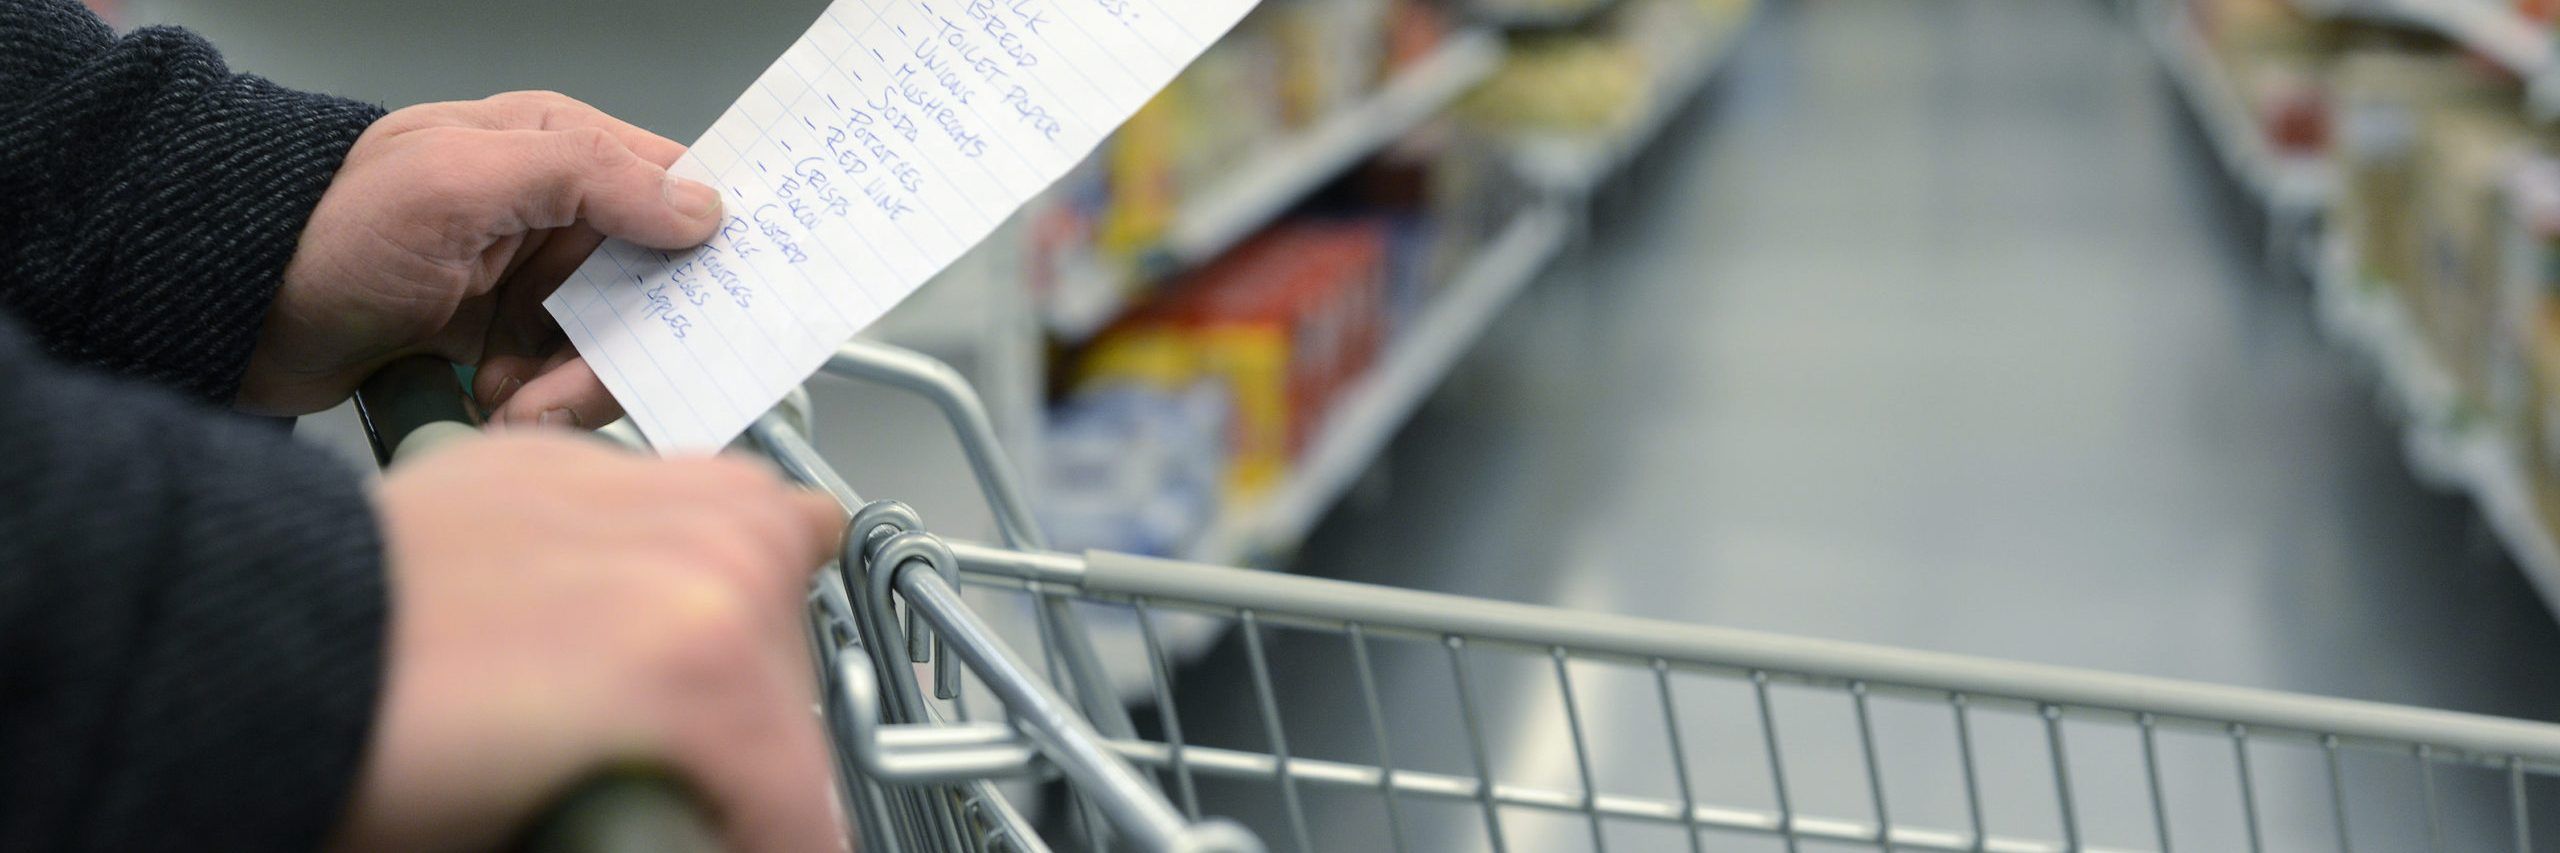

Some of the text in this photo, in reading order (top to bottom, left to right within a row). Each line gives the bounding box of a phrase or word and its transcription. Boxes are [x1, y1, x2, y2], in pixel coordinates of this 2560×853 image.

[914, 37, 976, 105] UNIONS
[939, 15, 1061, 142] TOILET PAPER
[895, 63, 989, 158] MUSHROOMS
[826, 125, 915, 220] RED WINE
[846, 107, 924, 194] POTATOES
[776, 174, 822, 230] BACON
[794, 156, 850, 216] CRISPS
[720, 215, 761, 259] RICE
[753, 203, 808, 265] CUSTARD
[671, 261, 711, 306] EGGS
